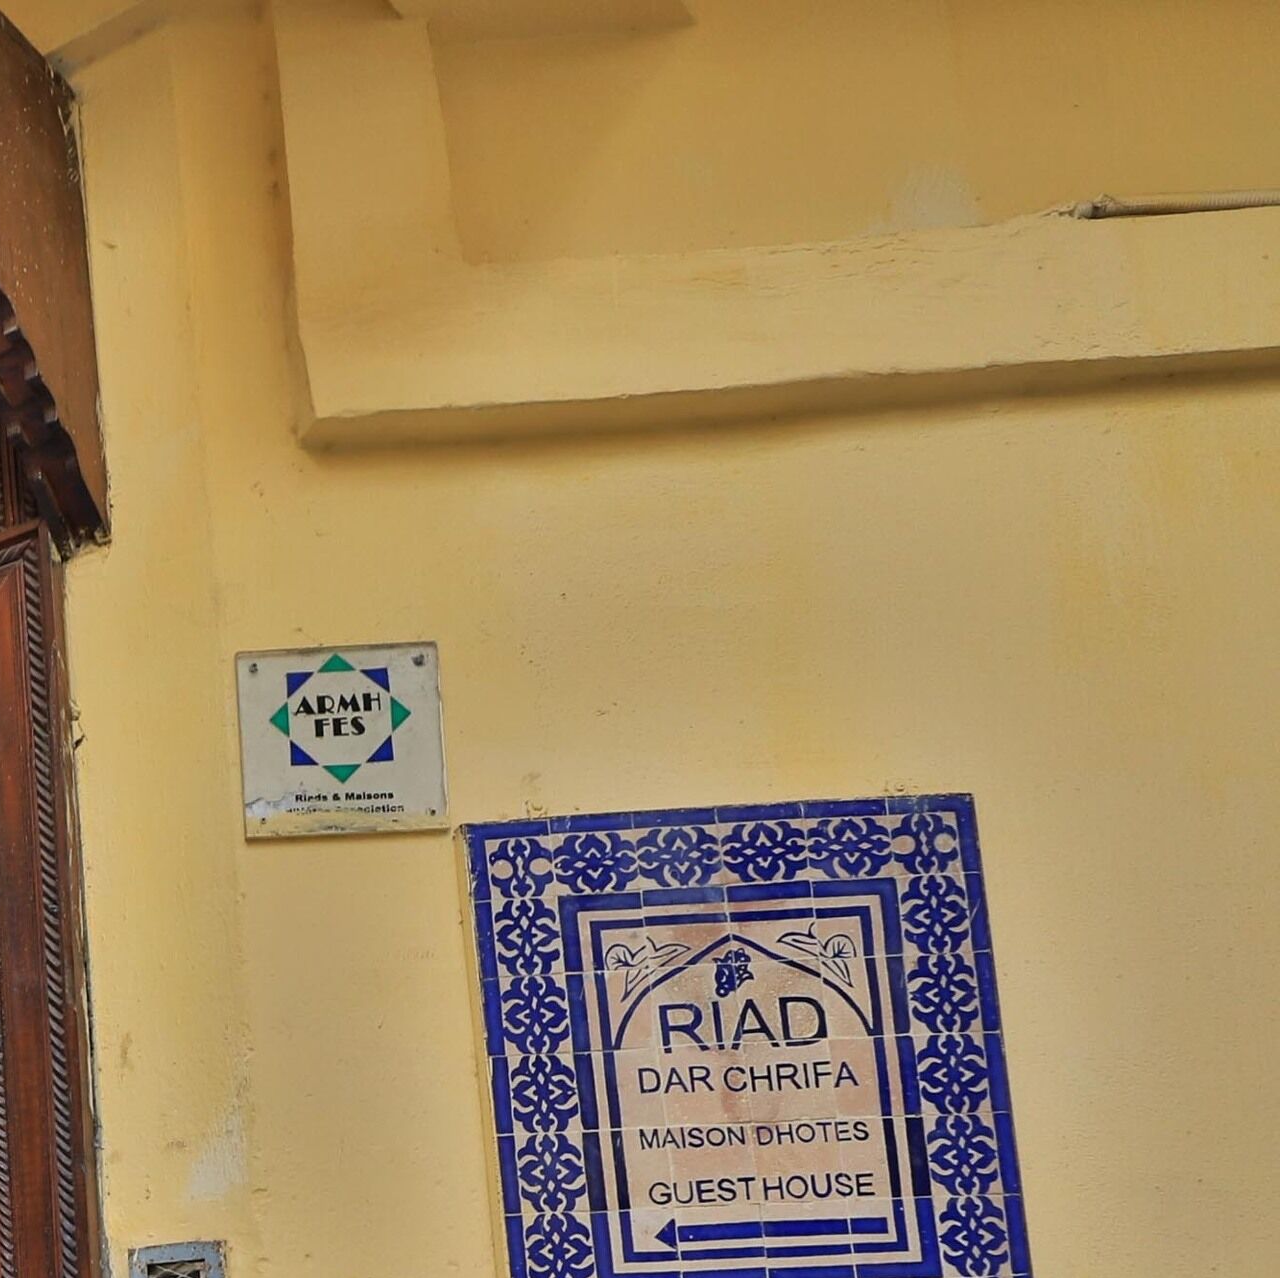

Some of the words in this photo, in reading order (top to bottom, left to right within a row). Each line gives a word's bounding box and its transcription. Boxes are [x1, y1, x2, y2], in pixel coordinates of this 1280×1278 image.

[293, 692, 382, 716] ARMH
[314, 716, 366, 738] FES
[332, 792, 341, 802] &
[345, 790, 394, 801] Maisons
[657, 995, 830, 1055] RIAD
[637, 1064, 716, 1095] DAR
[722, 1060, 860, 1094] CHRIFA
[638, 1126, 747, 1150] MAISON
[648, 1176, 757, 1206] GUEST
[762, 1172, 877, 1201] HOUSE
